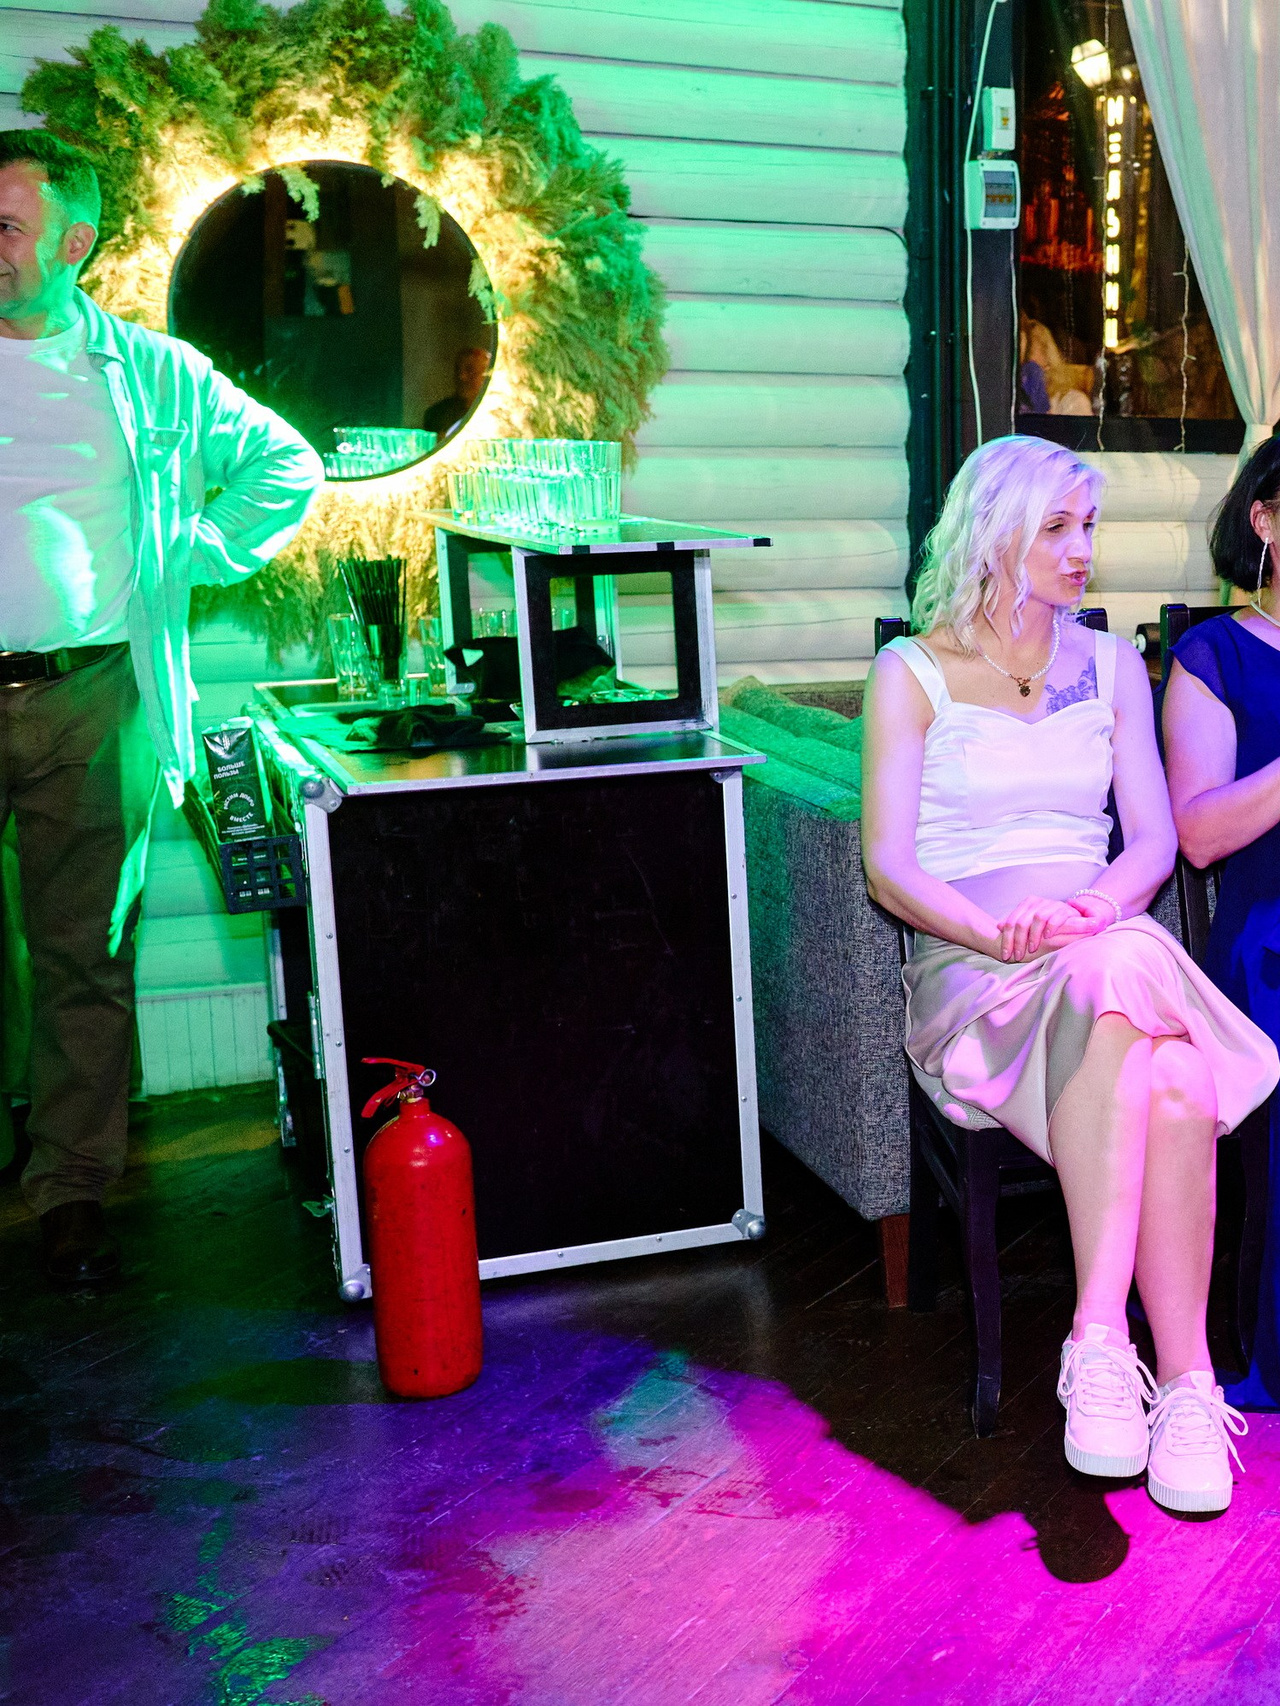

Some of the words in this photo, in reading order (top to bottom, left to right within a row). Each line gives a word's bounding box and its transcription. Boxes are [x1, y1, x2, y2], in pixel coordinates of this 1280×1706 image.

[217, 760, 245, 772] БОЛЬШЕ
[213, 769, 240, 780] ПОЛЬЗЫ
[229, 811, 254, 823] ВМЕСТЕ
